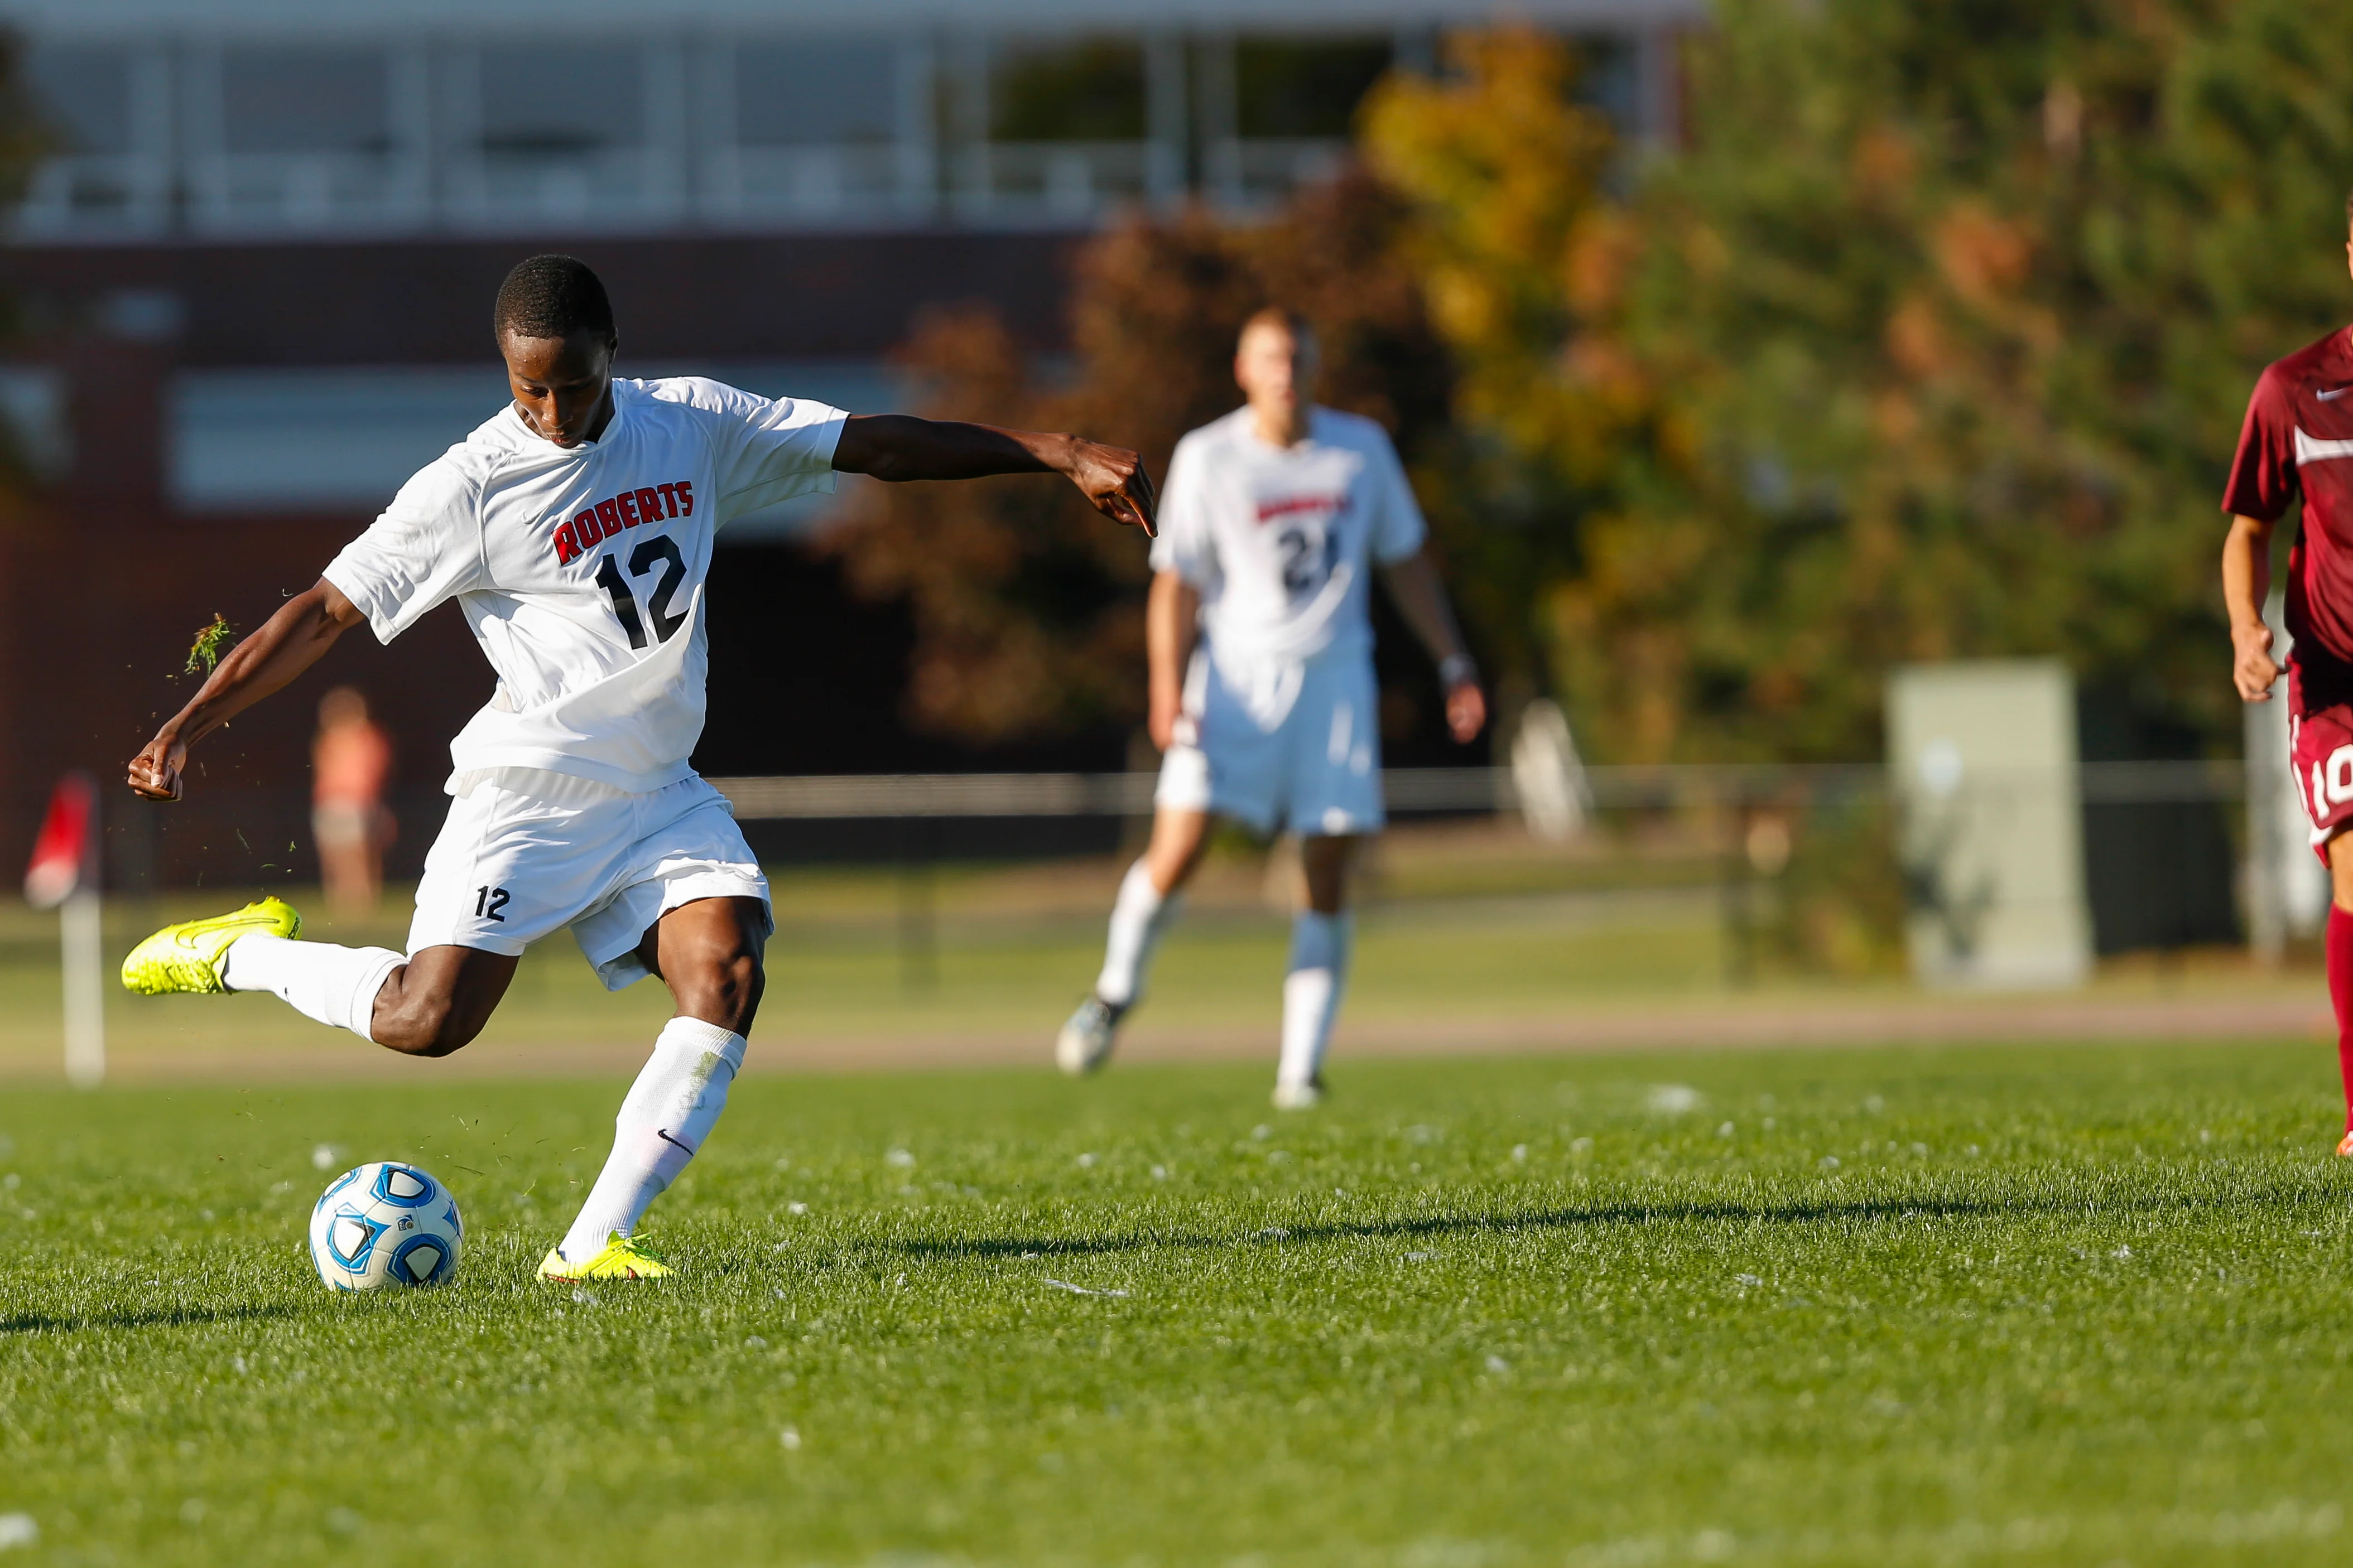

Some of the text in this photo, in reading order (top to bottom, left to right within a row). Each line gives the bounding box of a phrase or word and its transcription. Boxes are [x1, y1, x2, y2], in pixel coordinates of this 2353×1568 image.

[551, 480, 694, 566] ROBERTS
[595, 534, 690, 650] 12
[475, 885, 511, 923] 12
